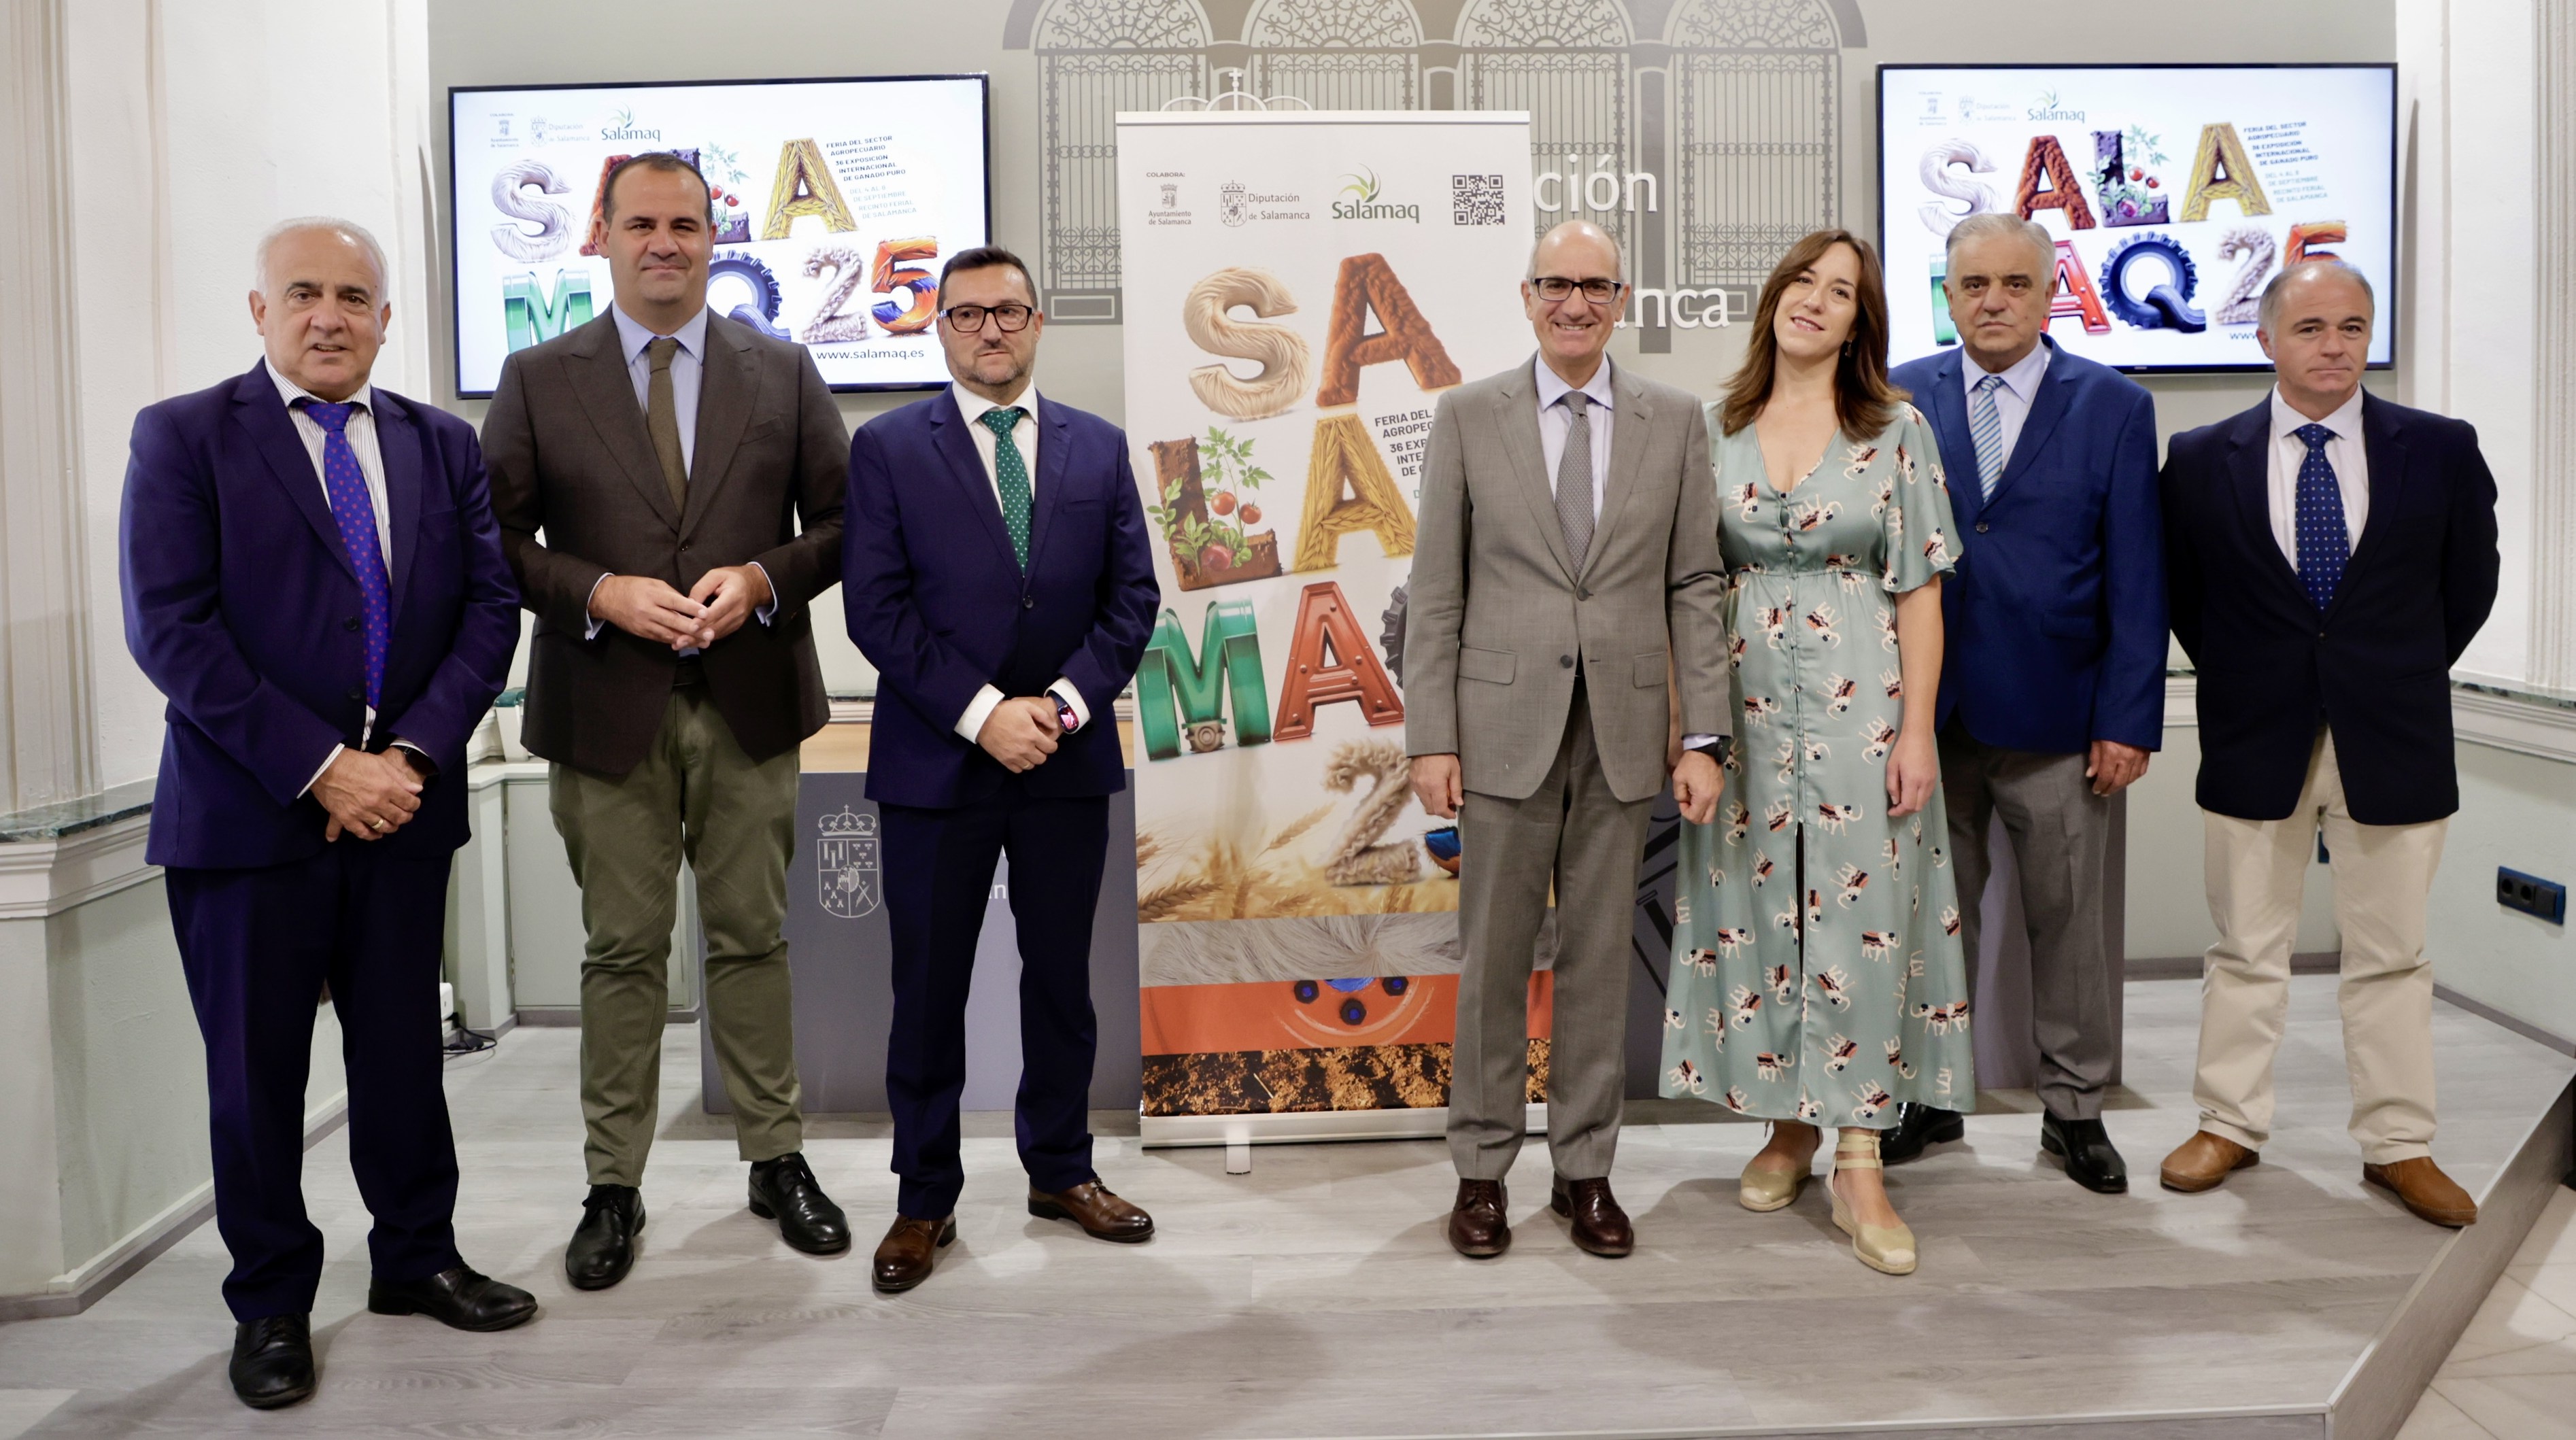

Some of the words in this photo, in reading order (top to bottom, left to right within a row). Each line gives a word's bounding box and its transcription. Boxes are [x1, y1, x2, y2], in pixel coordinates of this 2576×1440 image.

[2028, 108, 2085, 124] Salamaq
[601, 127, 660, 141] Salamaq
[864, 135, 892, 143] SECTOR
[830, 145, 885, 156] AGROPECUARIO
[839, 162, 897, 173] INTERNACIONAL
[854, 171, 885, 180] GANADO
[1533, 154, 1658, 212] ción
[1249, 193, 1300, 205] Diputación
[1148, 210, 1191, 218] Ayuntamiento
[1249, 212, 1257, 220] de
[1261, 211, 1310, 220] Salamanca
[1332, 200, 1420, 224] Salamaq
[1614, 288, 1731, 329] nca
[816, 349, 924, 360] www.salamaq.es
[1375, 413, 1408, 427] FERIA
[1410, 409, 1432, 421] DEL
[1390, 443, 1404, 453] 36
[1397, 452, 1424, 464] INTE
[1402, 466, 1417, 476] DE
